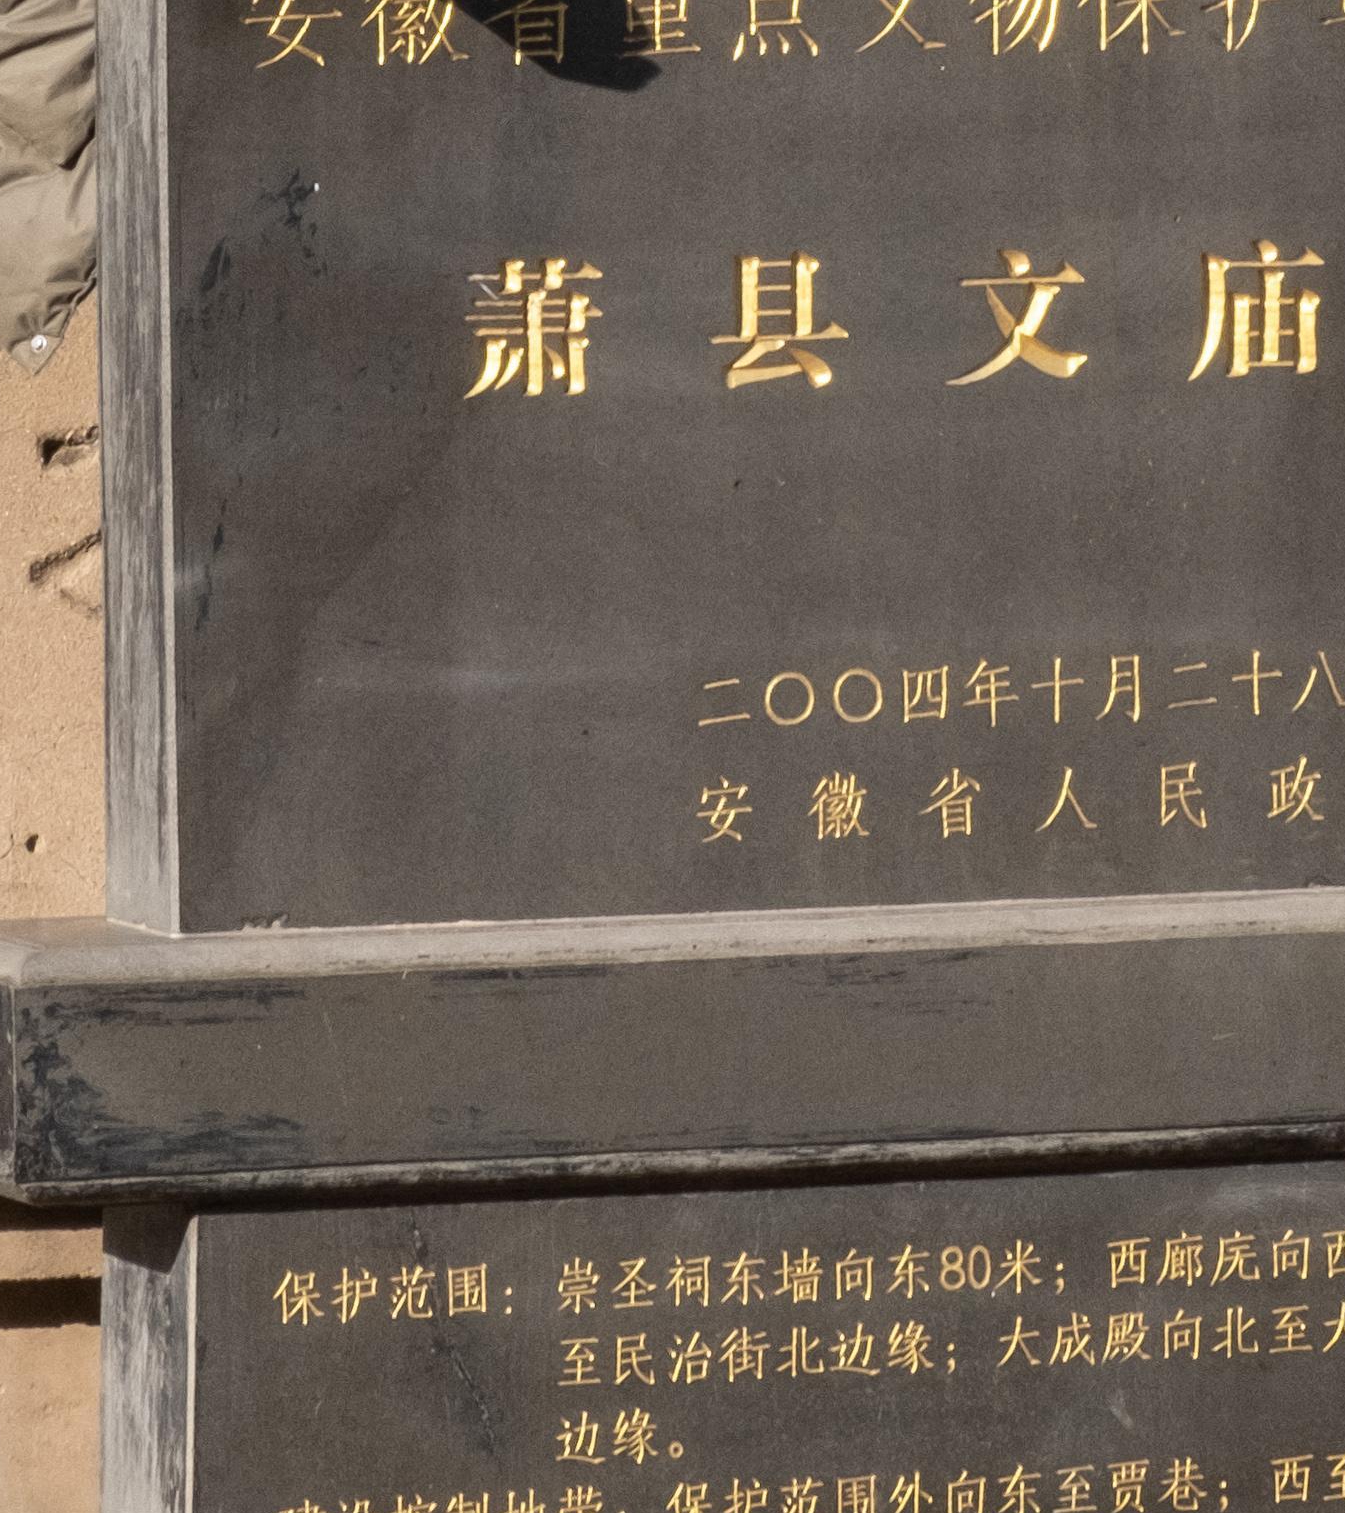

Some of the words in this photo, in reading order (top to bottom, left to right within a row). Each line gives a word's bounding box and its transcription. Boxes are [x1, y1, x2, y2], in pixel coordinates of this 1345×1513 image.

[463, 237, 1326, 400] 萧县文庙
[556, 1407, 684, 1465] 边缘。
